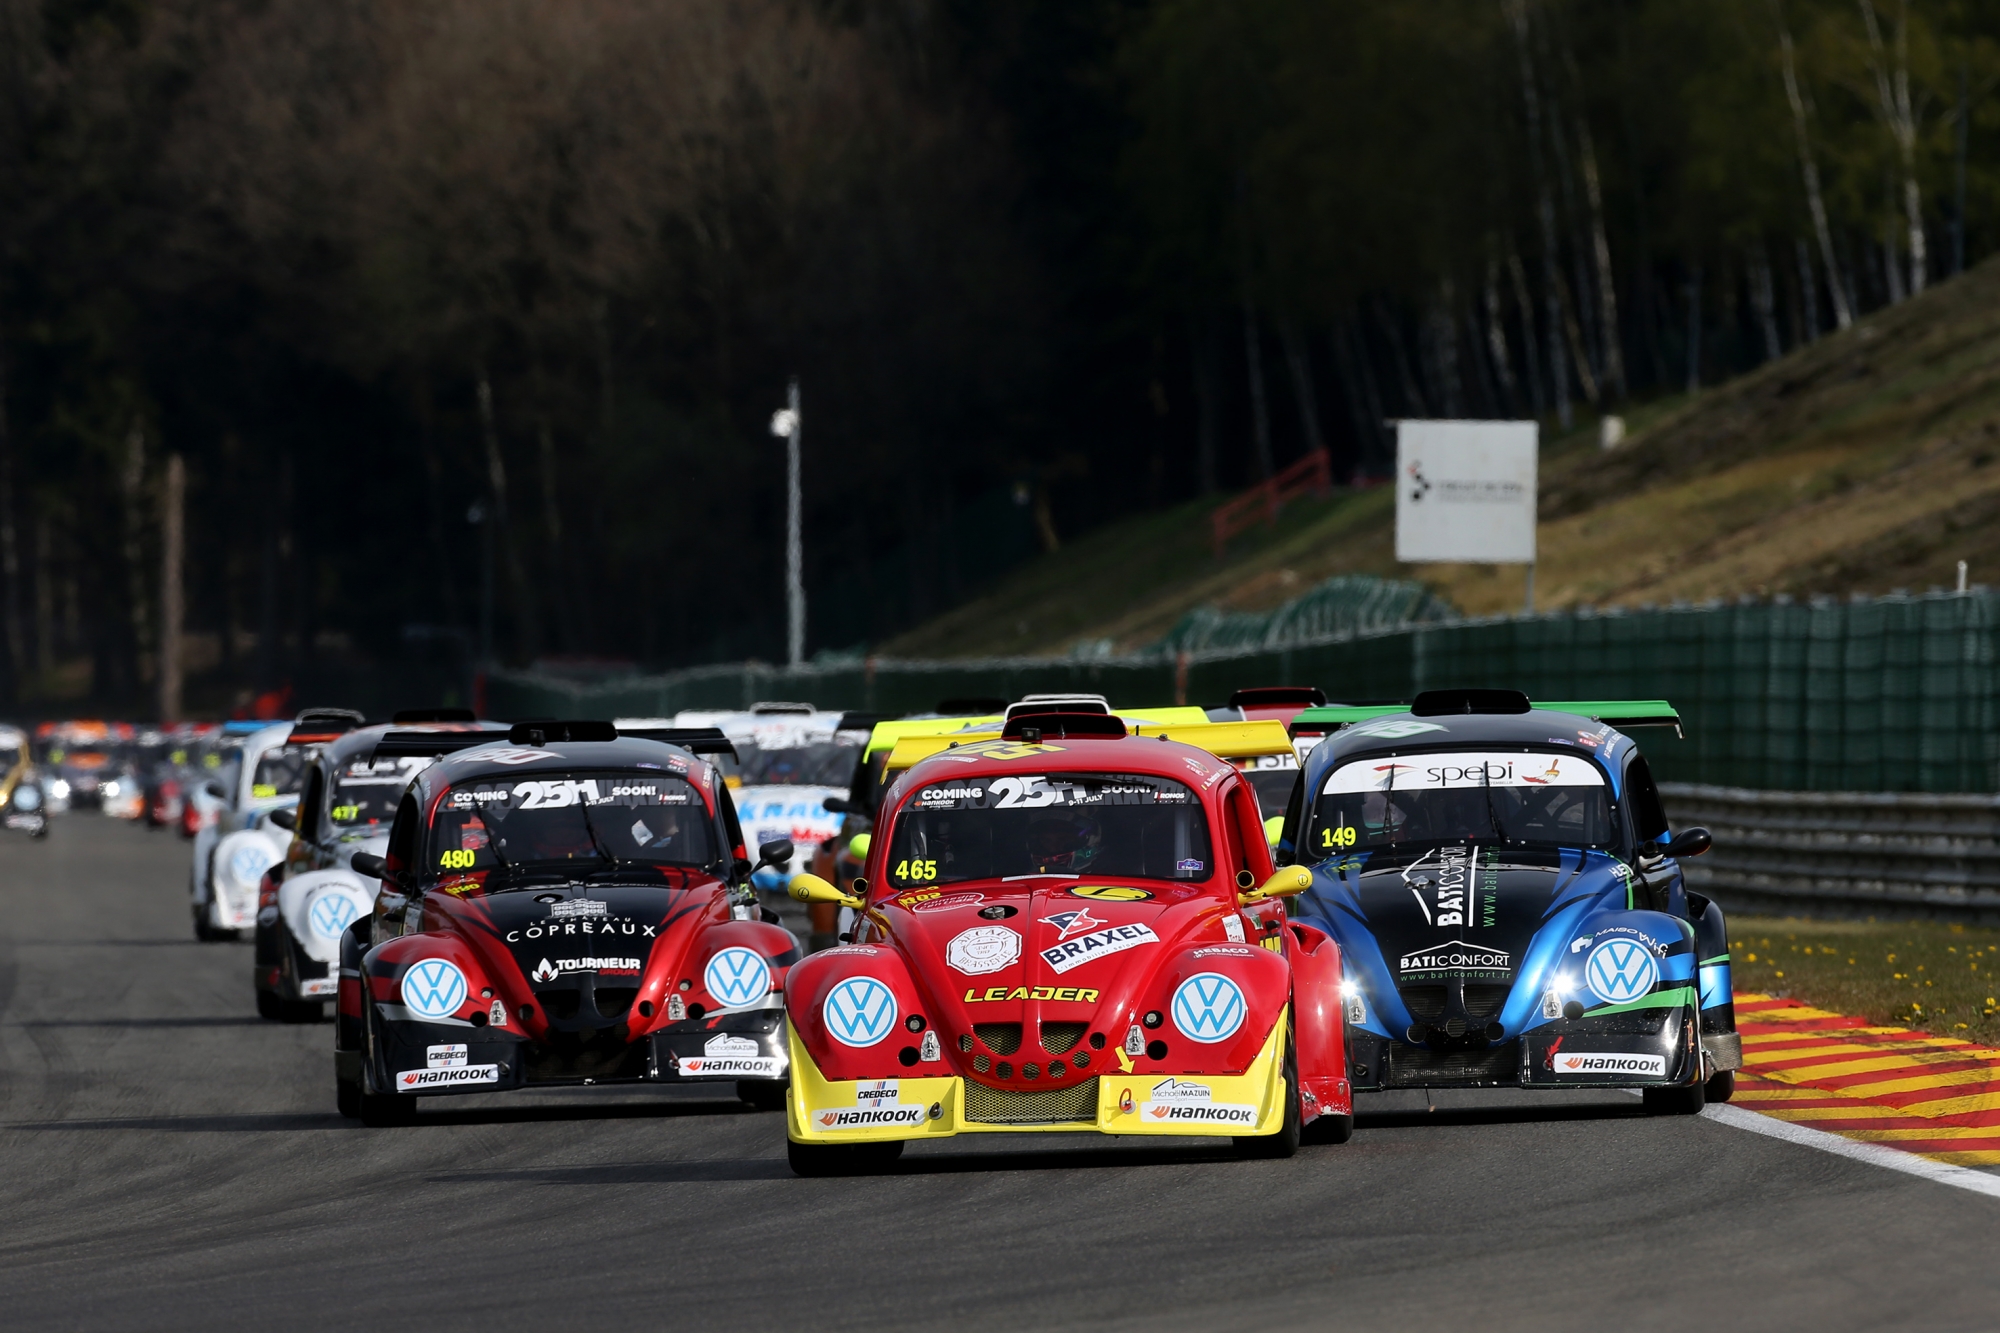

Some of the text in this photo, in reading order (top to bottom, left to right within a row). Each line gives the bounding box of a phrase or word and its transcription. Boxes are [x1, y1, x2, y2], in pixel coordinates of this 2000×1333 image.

[612, 786, 657, 796] SOON!
[922, 787, 983, 800] COMING
[1084, 794, 1103, 804] JULY
[1321, 827, 1357, 848] 149
[440, 849, 475, 869] 480
[895, 860, 937, 880] 465
[506, 922, 656, 942] COPREAUX
[1043, 925, 1142, 966] BRAXEL
[556, 957, 641, 970] TOURNEUR
[1400, 954, 1510, 968] BATICONFORT
[1400, 971, 1511, 981] www.baticonfort.fr
[964, 986, 1099, 1002] LEADER
[429, 1052, 466, 1060] CREDECO
[858, 1089, 897, 1099] CREDECO
